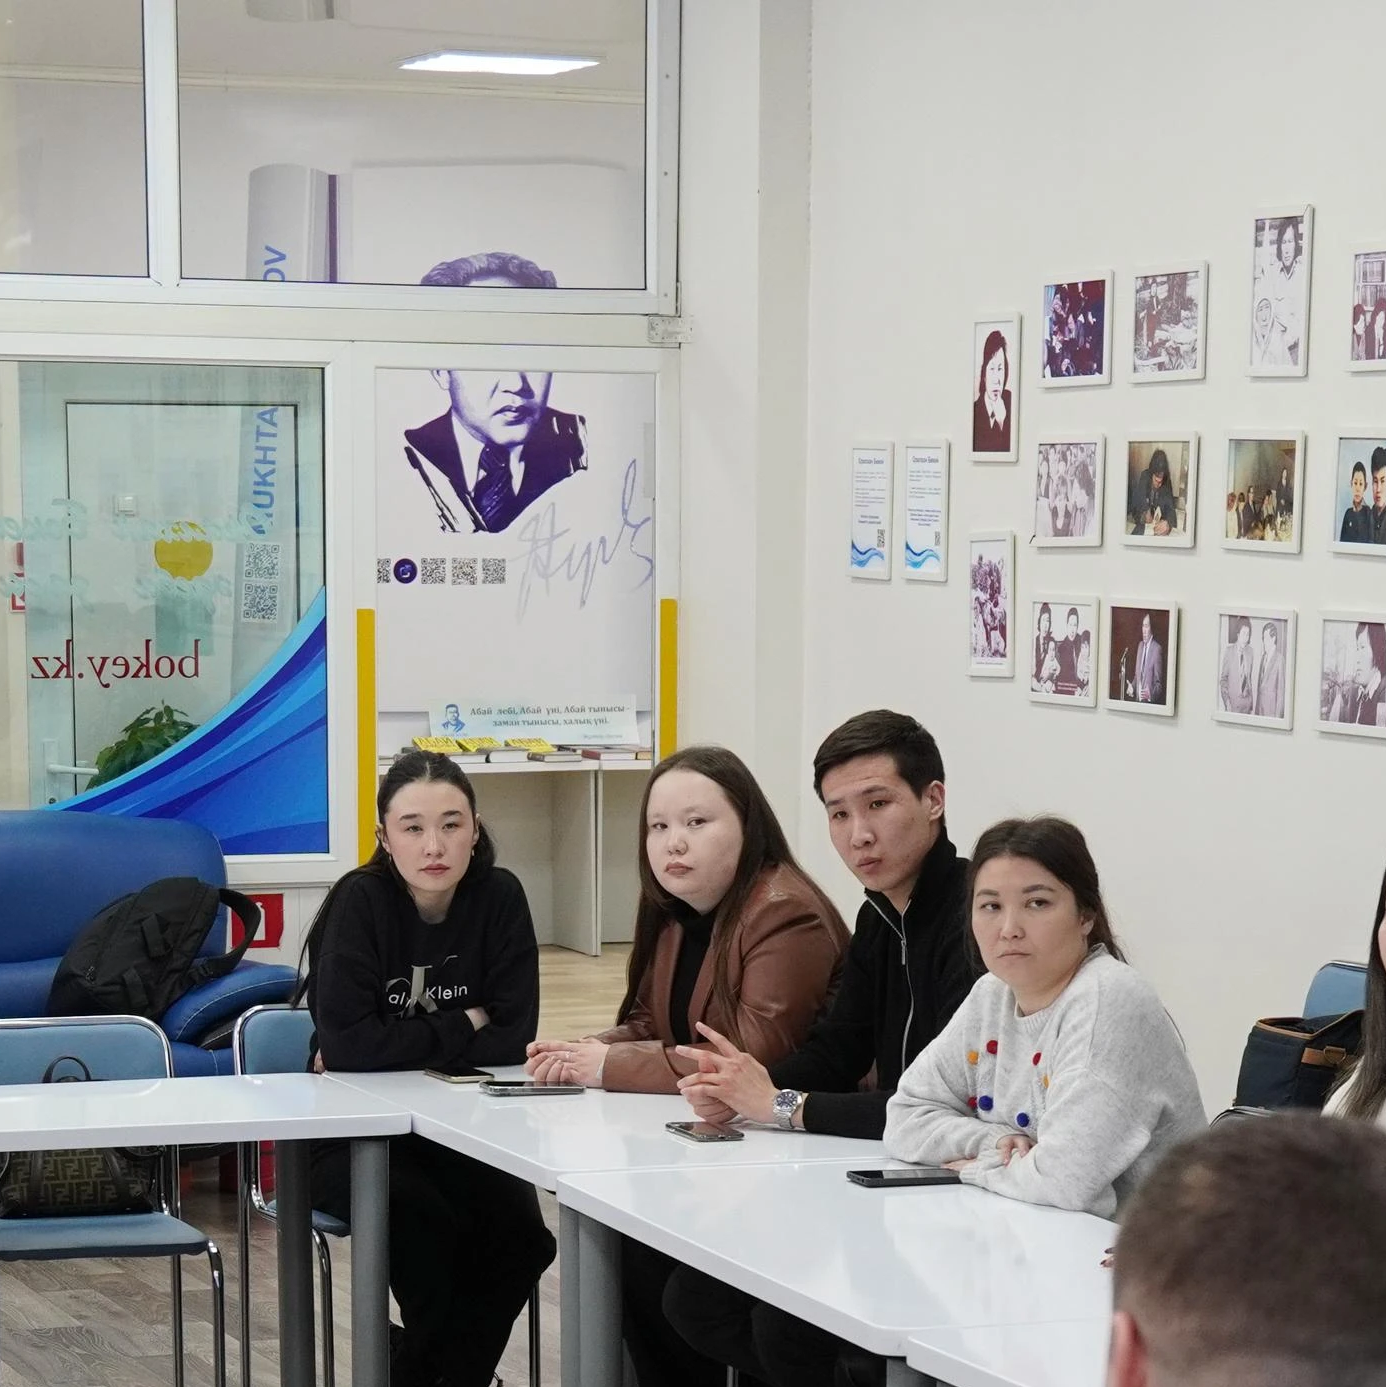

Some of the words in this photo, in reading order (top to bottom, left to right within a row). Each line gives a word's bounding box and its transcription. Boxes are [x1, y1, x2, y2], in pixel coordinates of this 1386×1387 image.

[251, 407, 279, 535] UKHTA
[470, 706, 493, 716] Абай
[519, 705, 542, 715] Абай
[564, 704, 586, 715] Абай
[425, 985, 468, 1000] Klein
